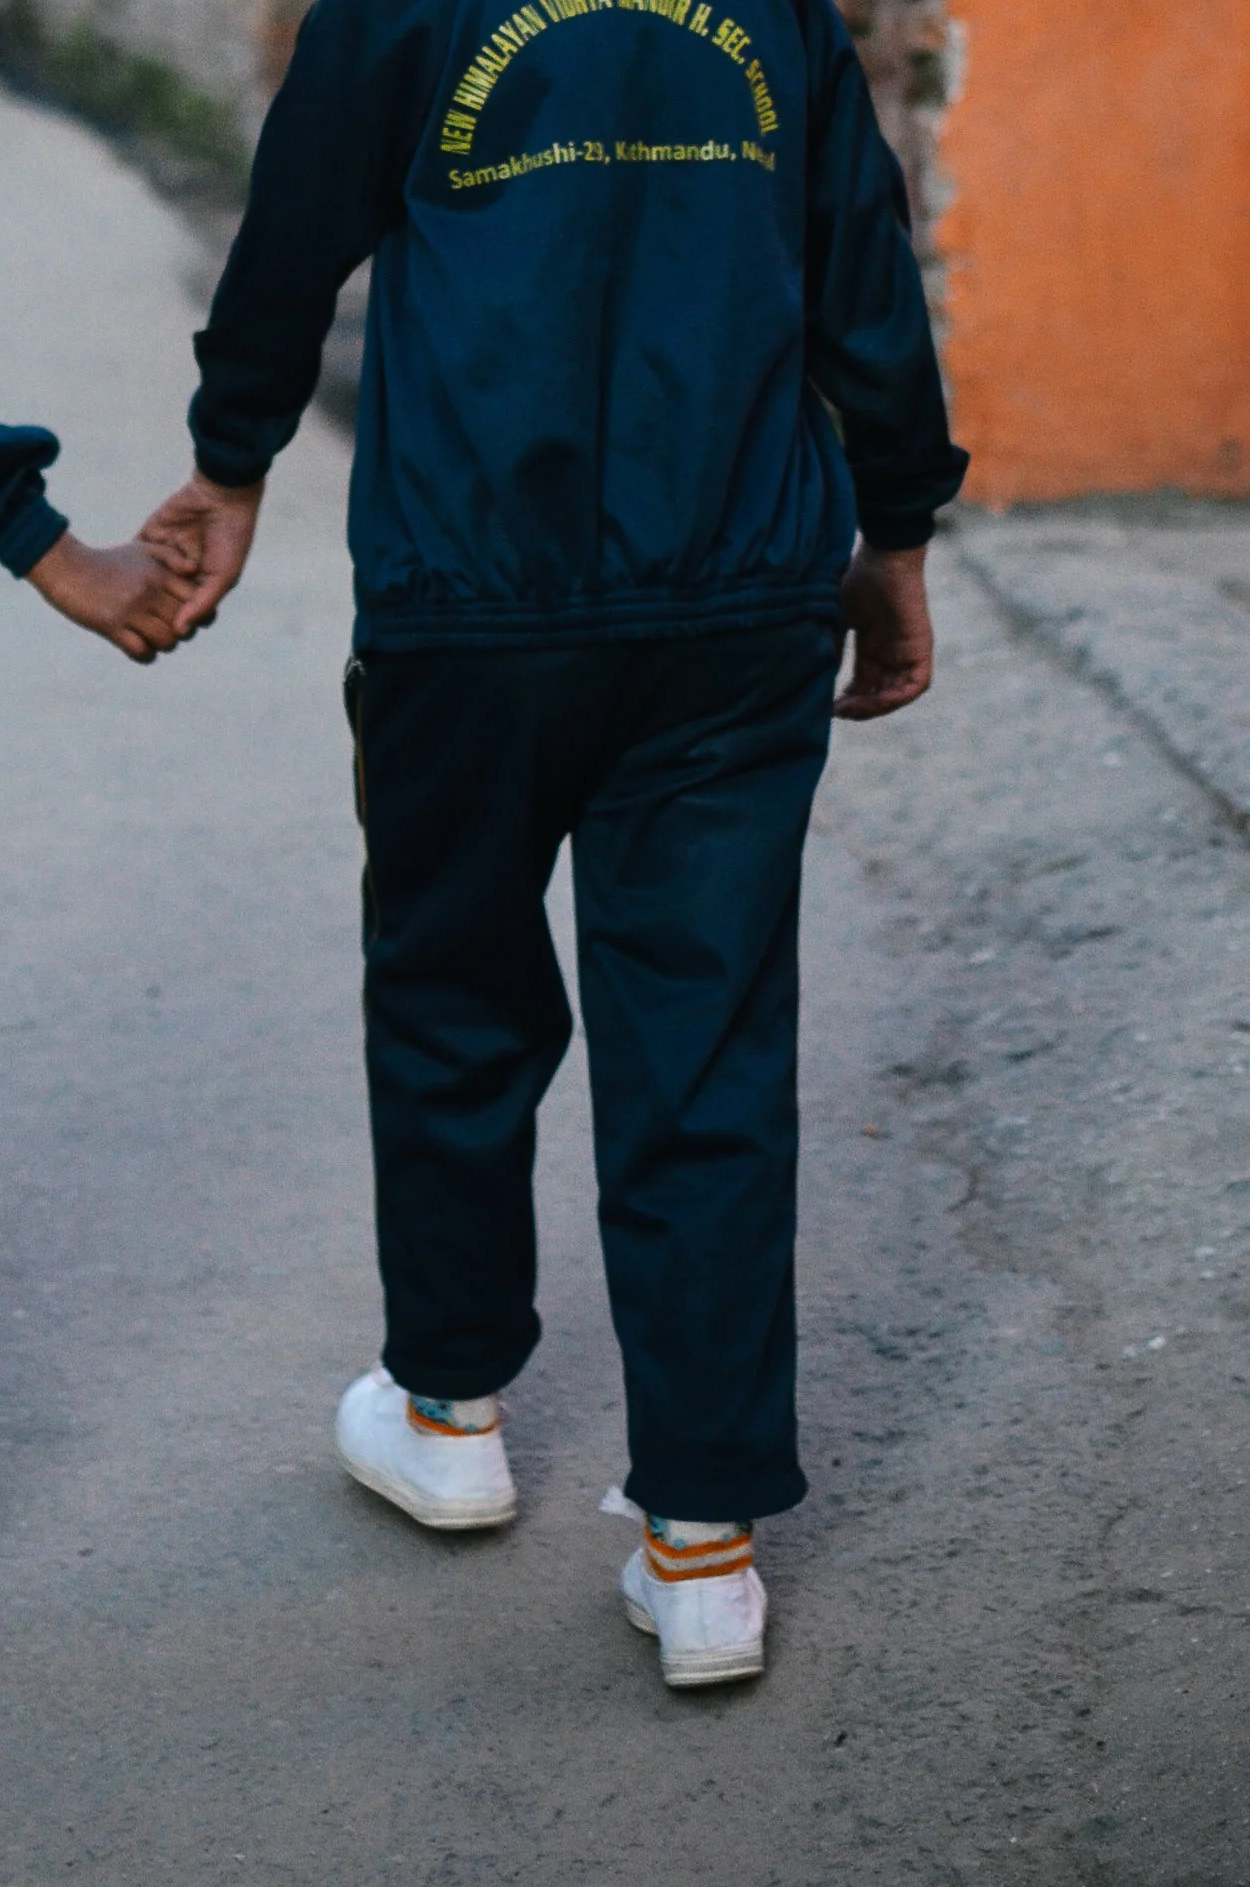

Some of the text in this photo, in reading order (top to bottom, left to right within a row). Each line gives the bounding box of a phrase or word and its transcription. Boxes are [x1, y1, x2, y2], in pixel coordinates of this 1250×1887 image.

[453, 4, 547, 110] HIMALAYAN
[440, 109, 477, 155] NEW
[615, 139, 737, 161] Kthmandu,
